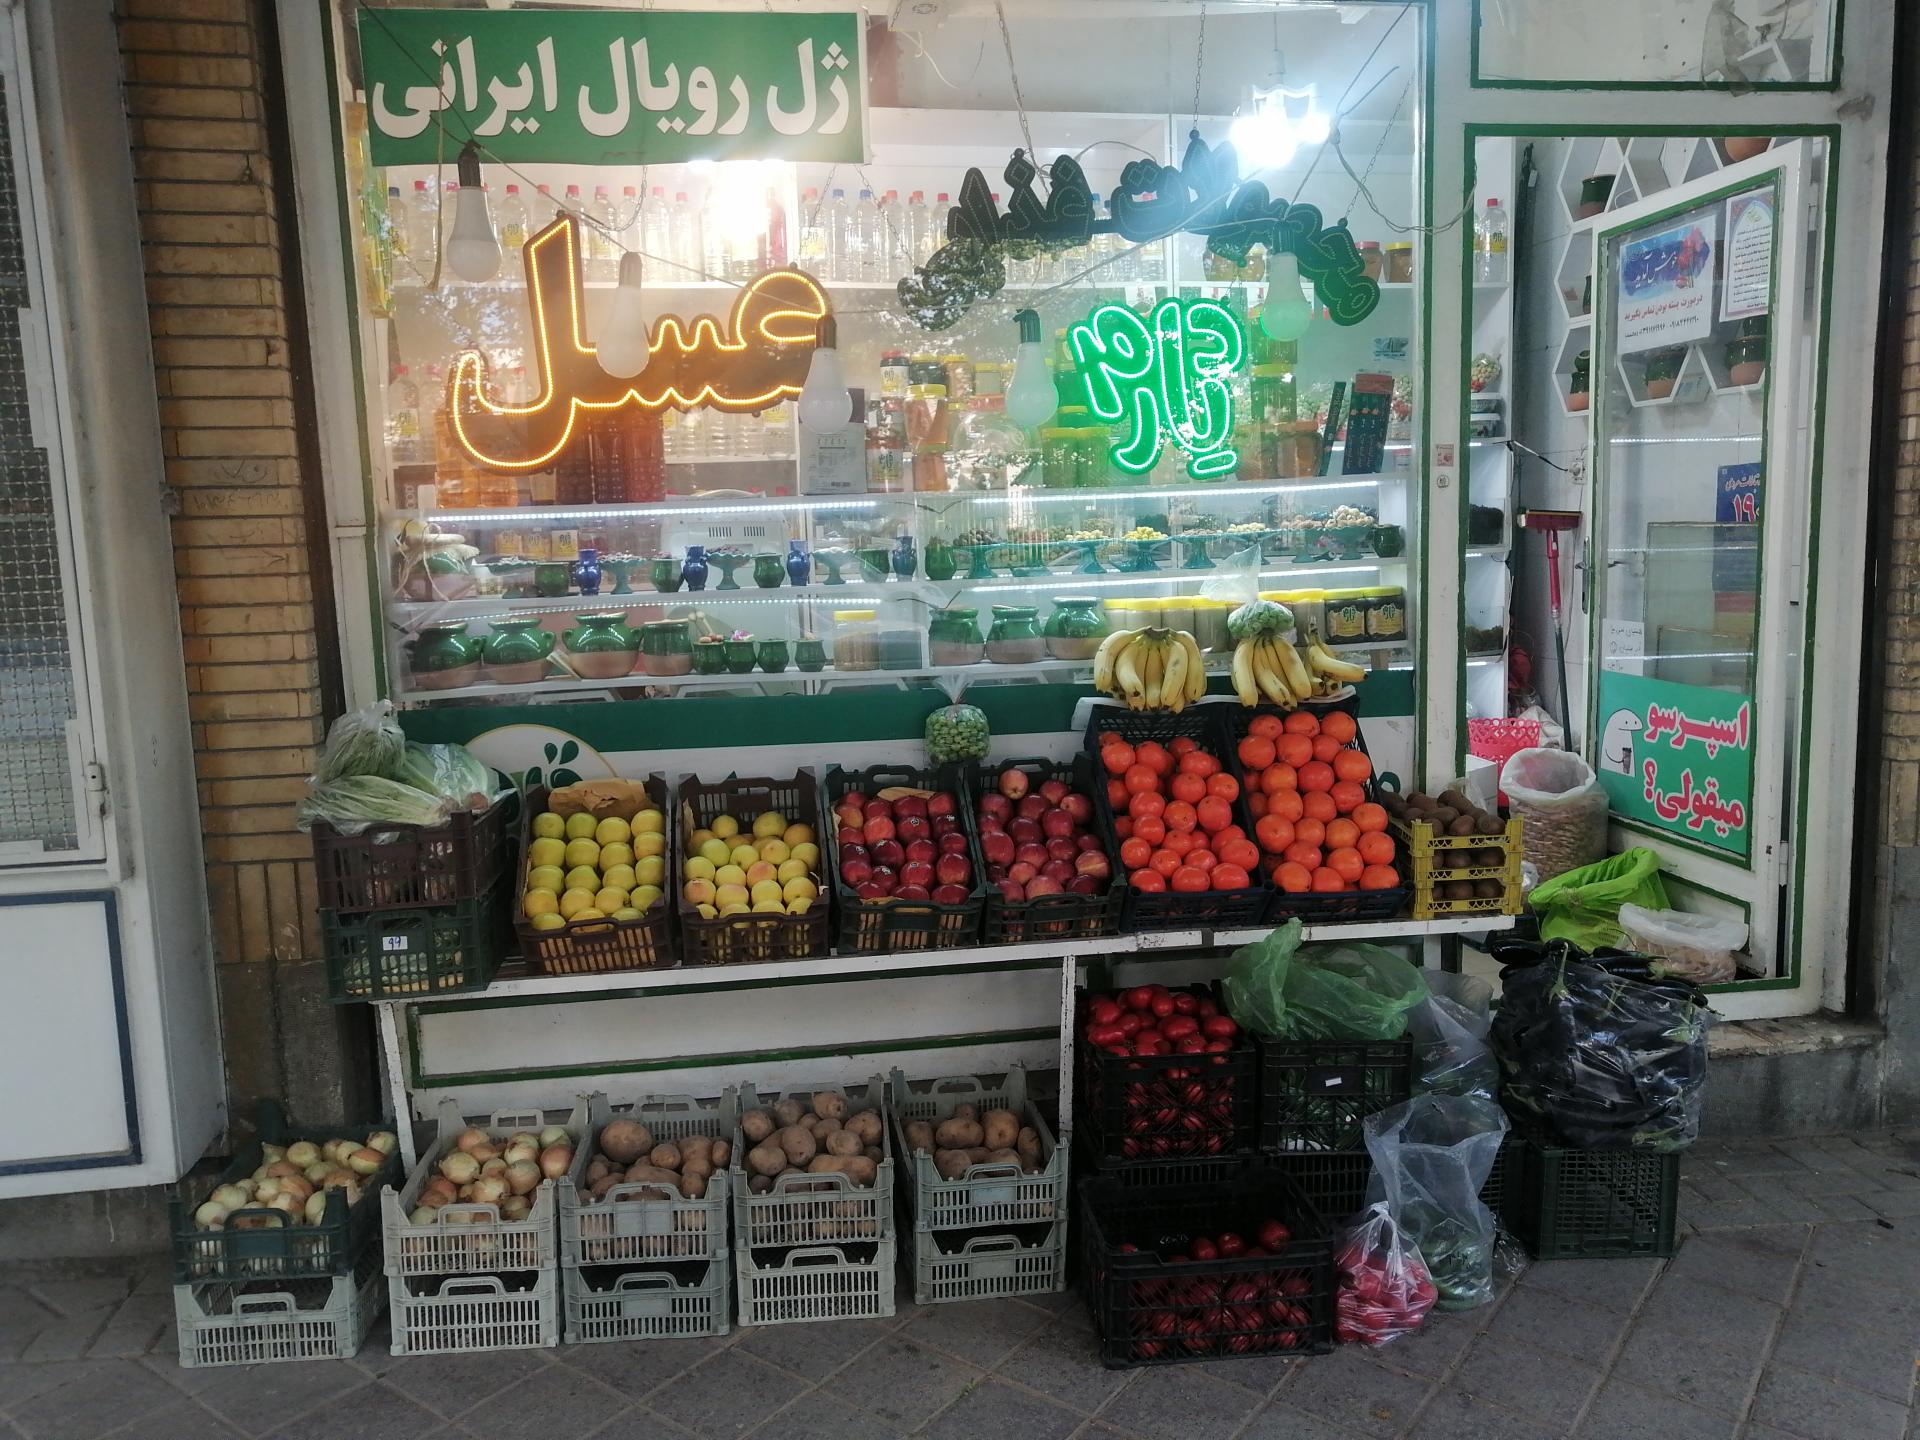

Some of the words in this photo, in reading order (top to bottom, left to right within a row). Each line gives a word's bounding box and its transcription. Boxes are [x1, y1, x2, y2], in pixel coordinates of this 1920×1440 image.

[372, 35, 558, 138] ایرانی
[578, 36, 750, 137] رویال
[766, 40, 851, 135] ژل
[451, 215, 828, 471] عسل
[1645, 702, 1749, 758] اسپرسو
[1643, 759, 1745, 836] میقولی؟
